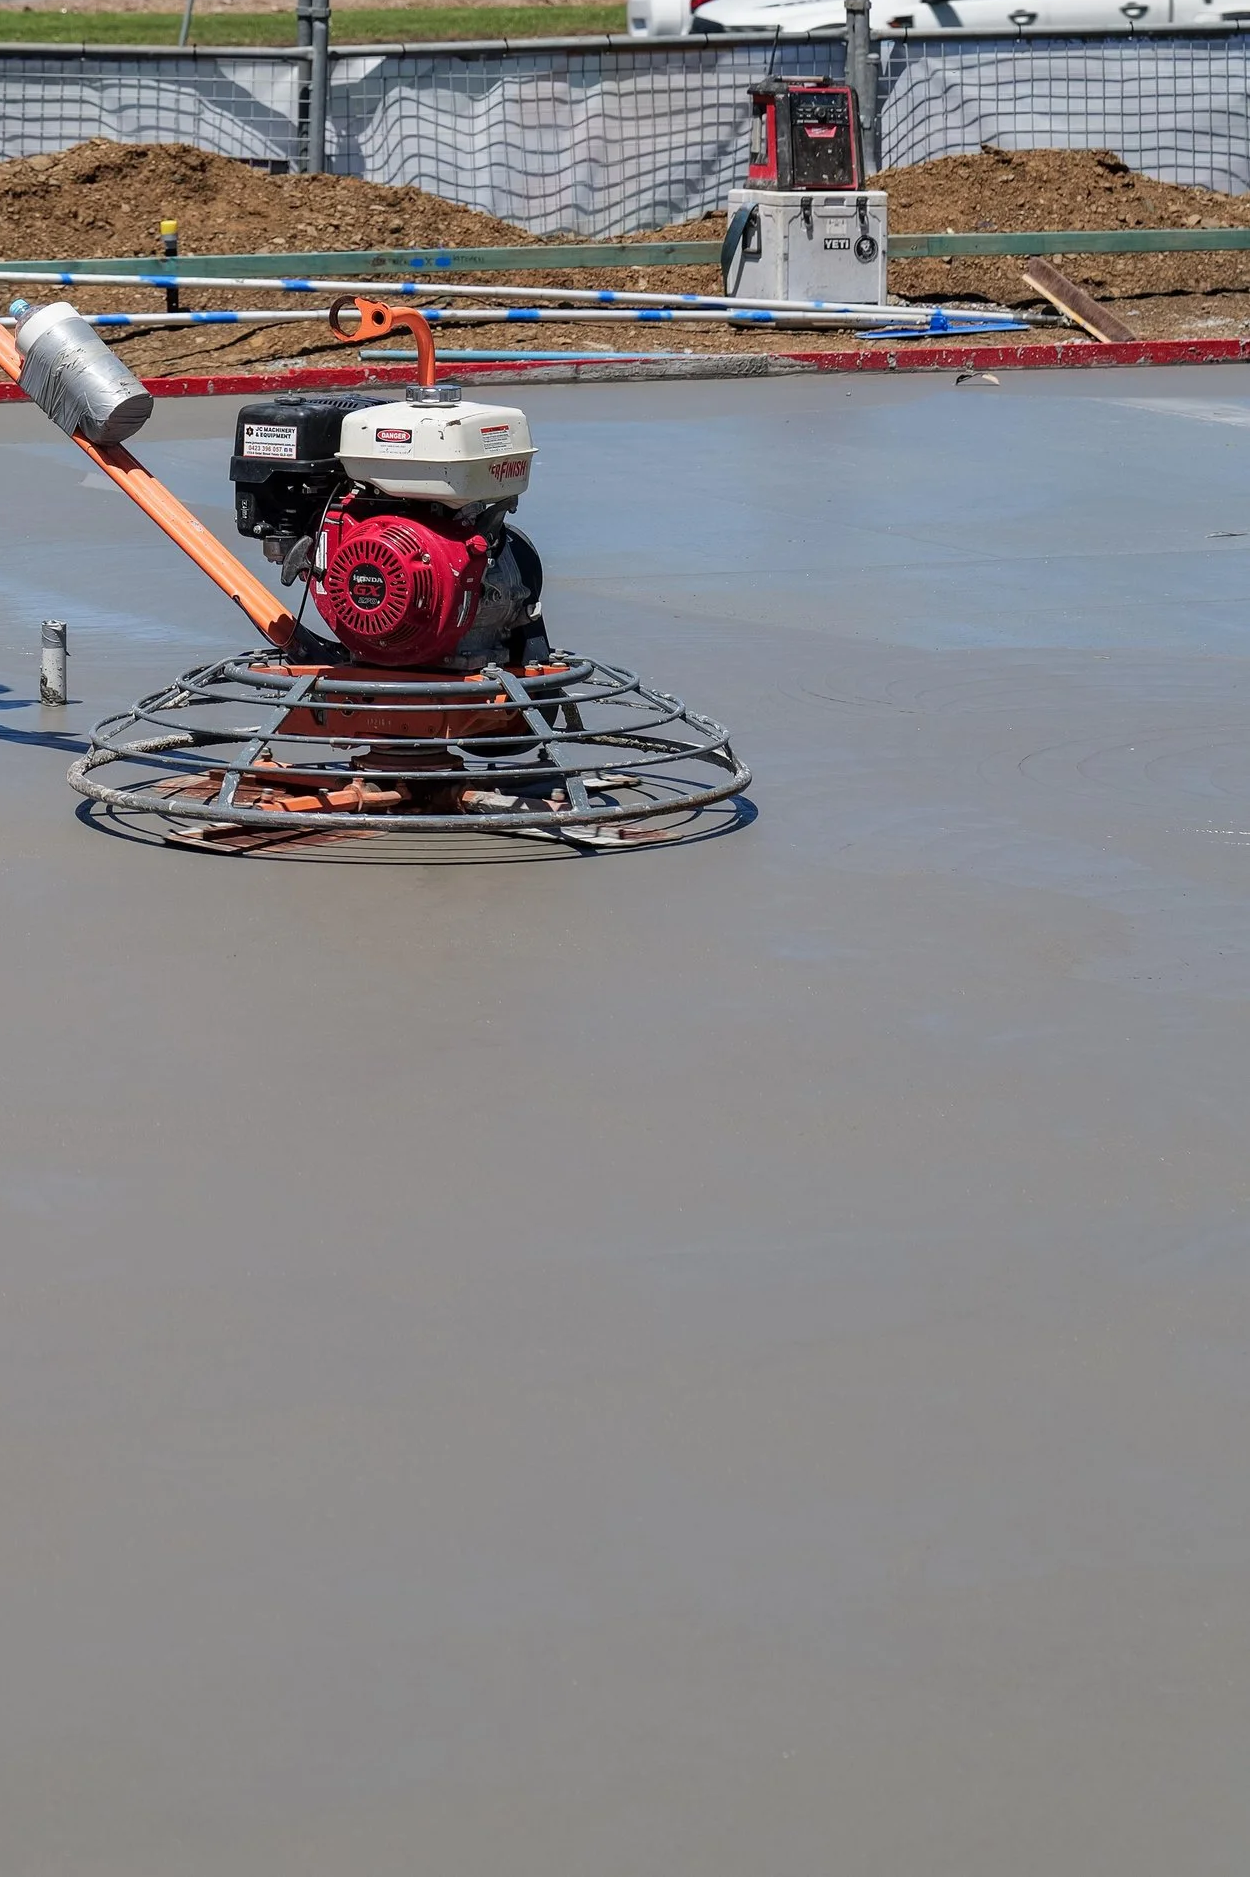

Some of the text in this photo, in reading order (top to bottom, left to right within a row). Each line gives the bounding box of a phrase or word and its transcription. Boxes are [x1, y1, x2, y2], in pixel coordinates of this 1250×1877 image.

[824, 239, 849, 249] YETI
[381, 432, 407, 440] DANGER
[352, 574, 383, 583] HONDA
[353, 584, 381, 597] GX
